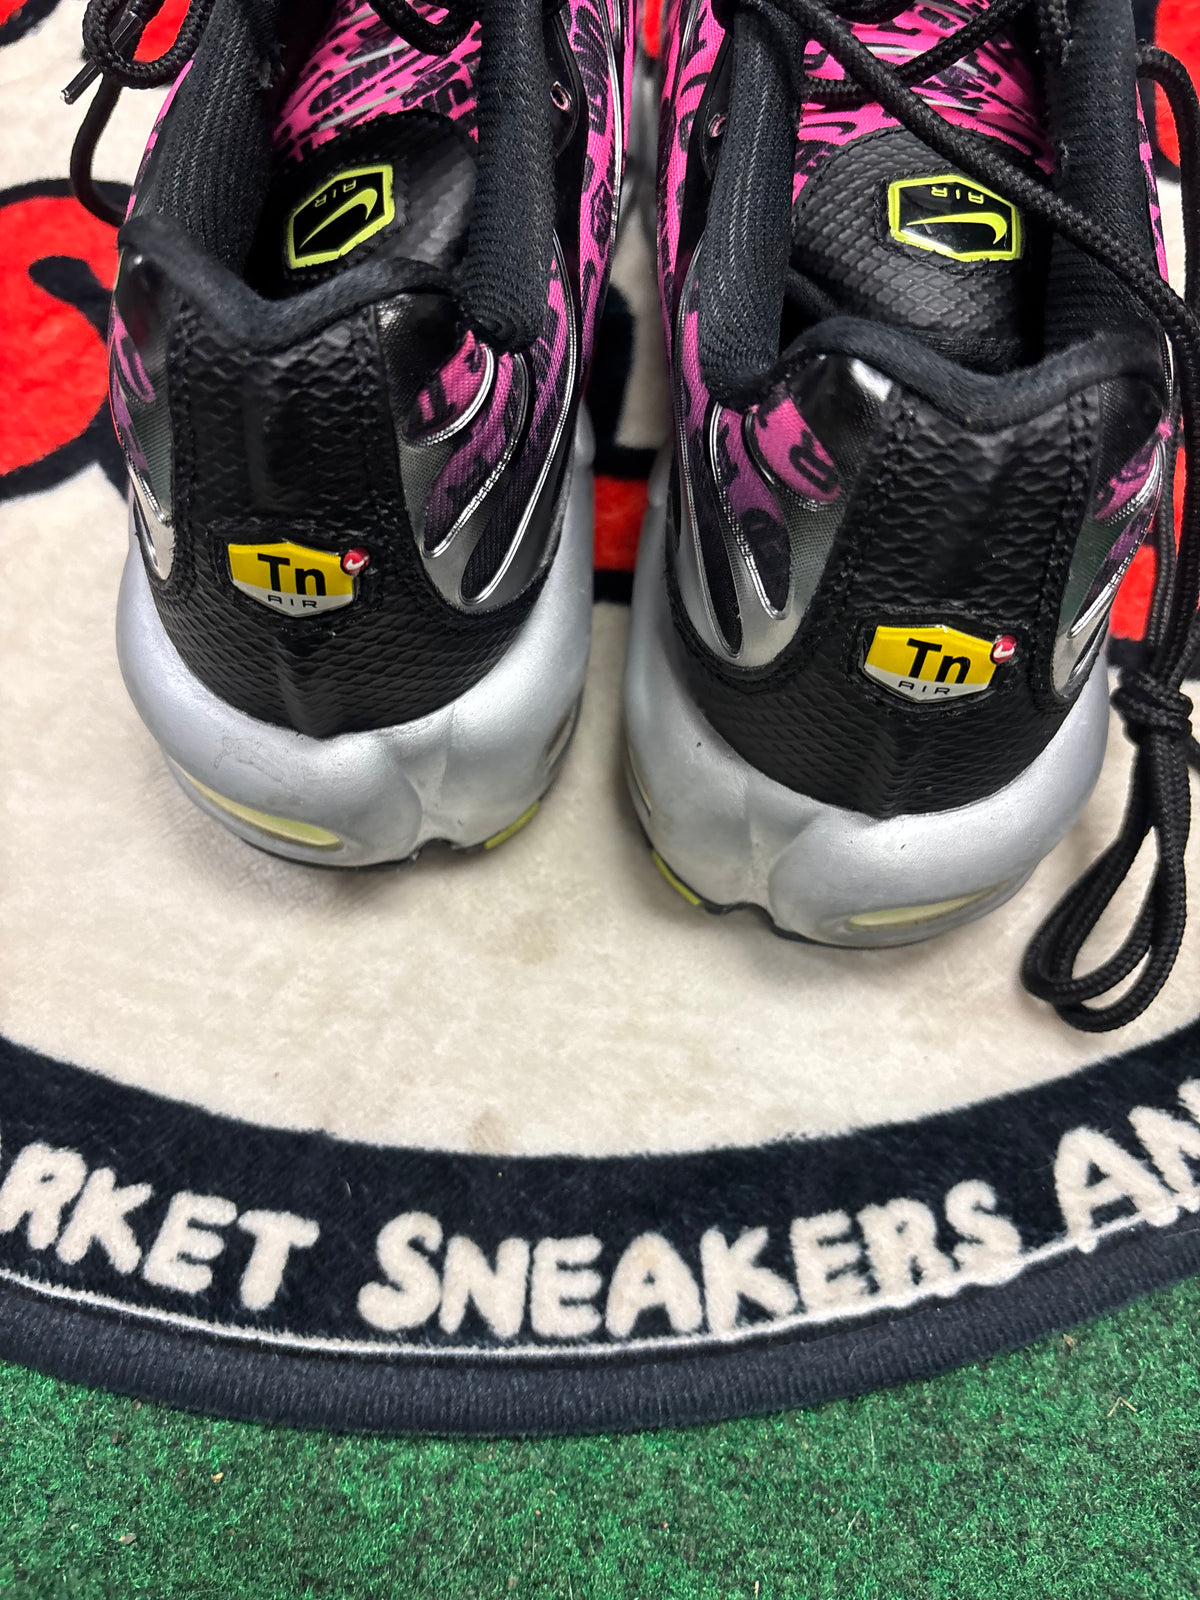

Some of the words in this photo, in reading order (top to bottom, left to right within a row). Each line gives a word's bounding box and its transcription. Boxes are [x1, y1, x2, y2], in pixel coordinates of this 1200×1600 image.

[314, 179, 357, 208] AIR
[931, 186, 984, 205] AIR
[257, 552, 327, 597] Tn
[267, 594, 318, 609] AIR
[906, 637, 971, 684] Tn
[898, 680, 951, 696] AIR
[0, 1141, 320, 1312] RKET
[357, 1179, 1024, 1340] SNEAKERS
